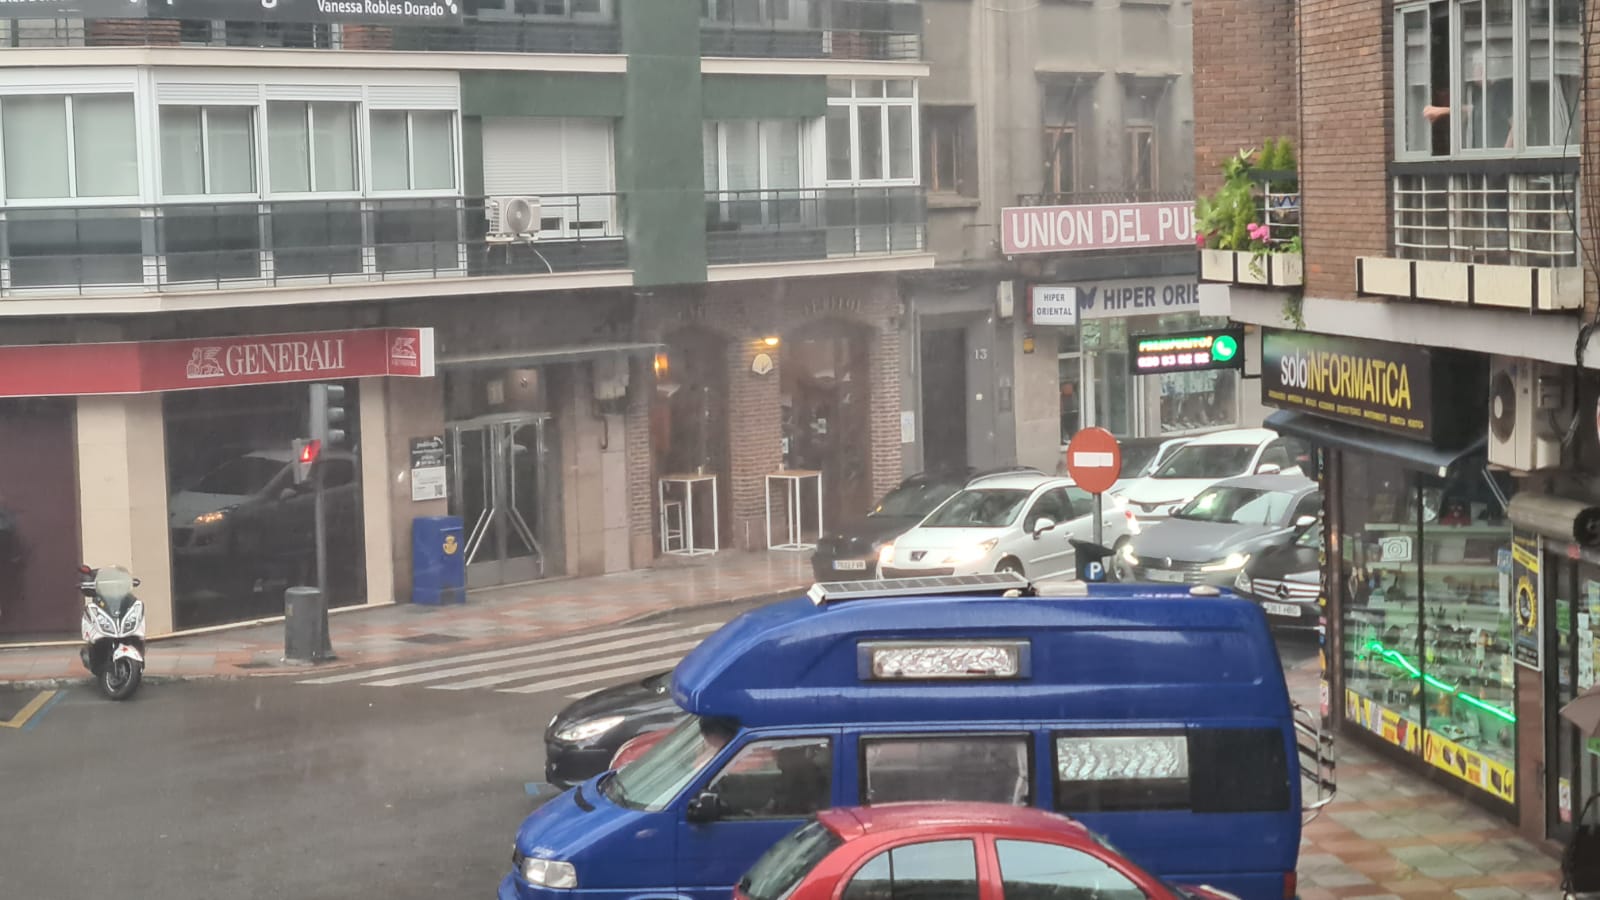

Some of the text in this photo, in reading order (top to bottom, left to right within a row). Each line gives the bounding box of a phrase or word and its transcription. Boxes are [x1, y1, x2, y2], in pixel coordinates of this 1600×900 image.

[317, 0, 444, 16] Vanessa Robles Dorado
[1012, 210, 1094, 248] UNION
[1101, 208, 1150, 244] DEL
[1043, 293, 1065, 302] HIPER
[1103, 285, 1156, 311] HIPER
[1036, 306, 1073, 316] ORIENTAL
[225, 338, 345, 376] GENERALI
[975, 348, 988, 360] 13
[1089, 561, 1102, 580] P
